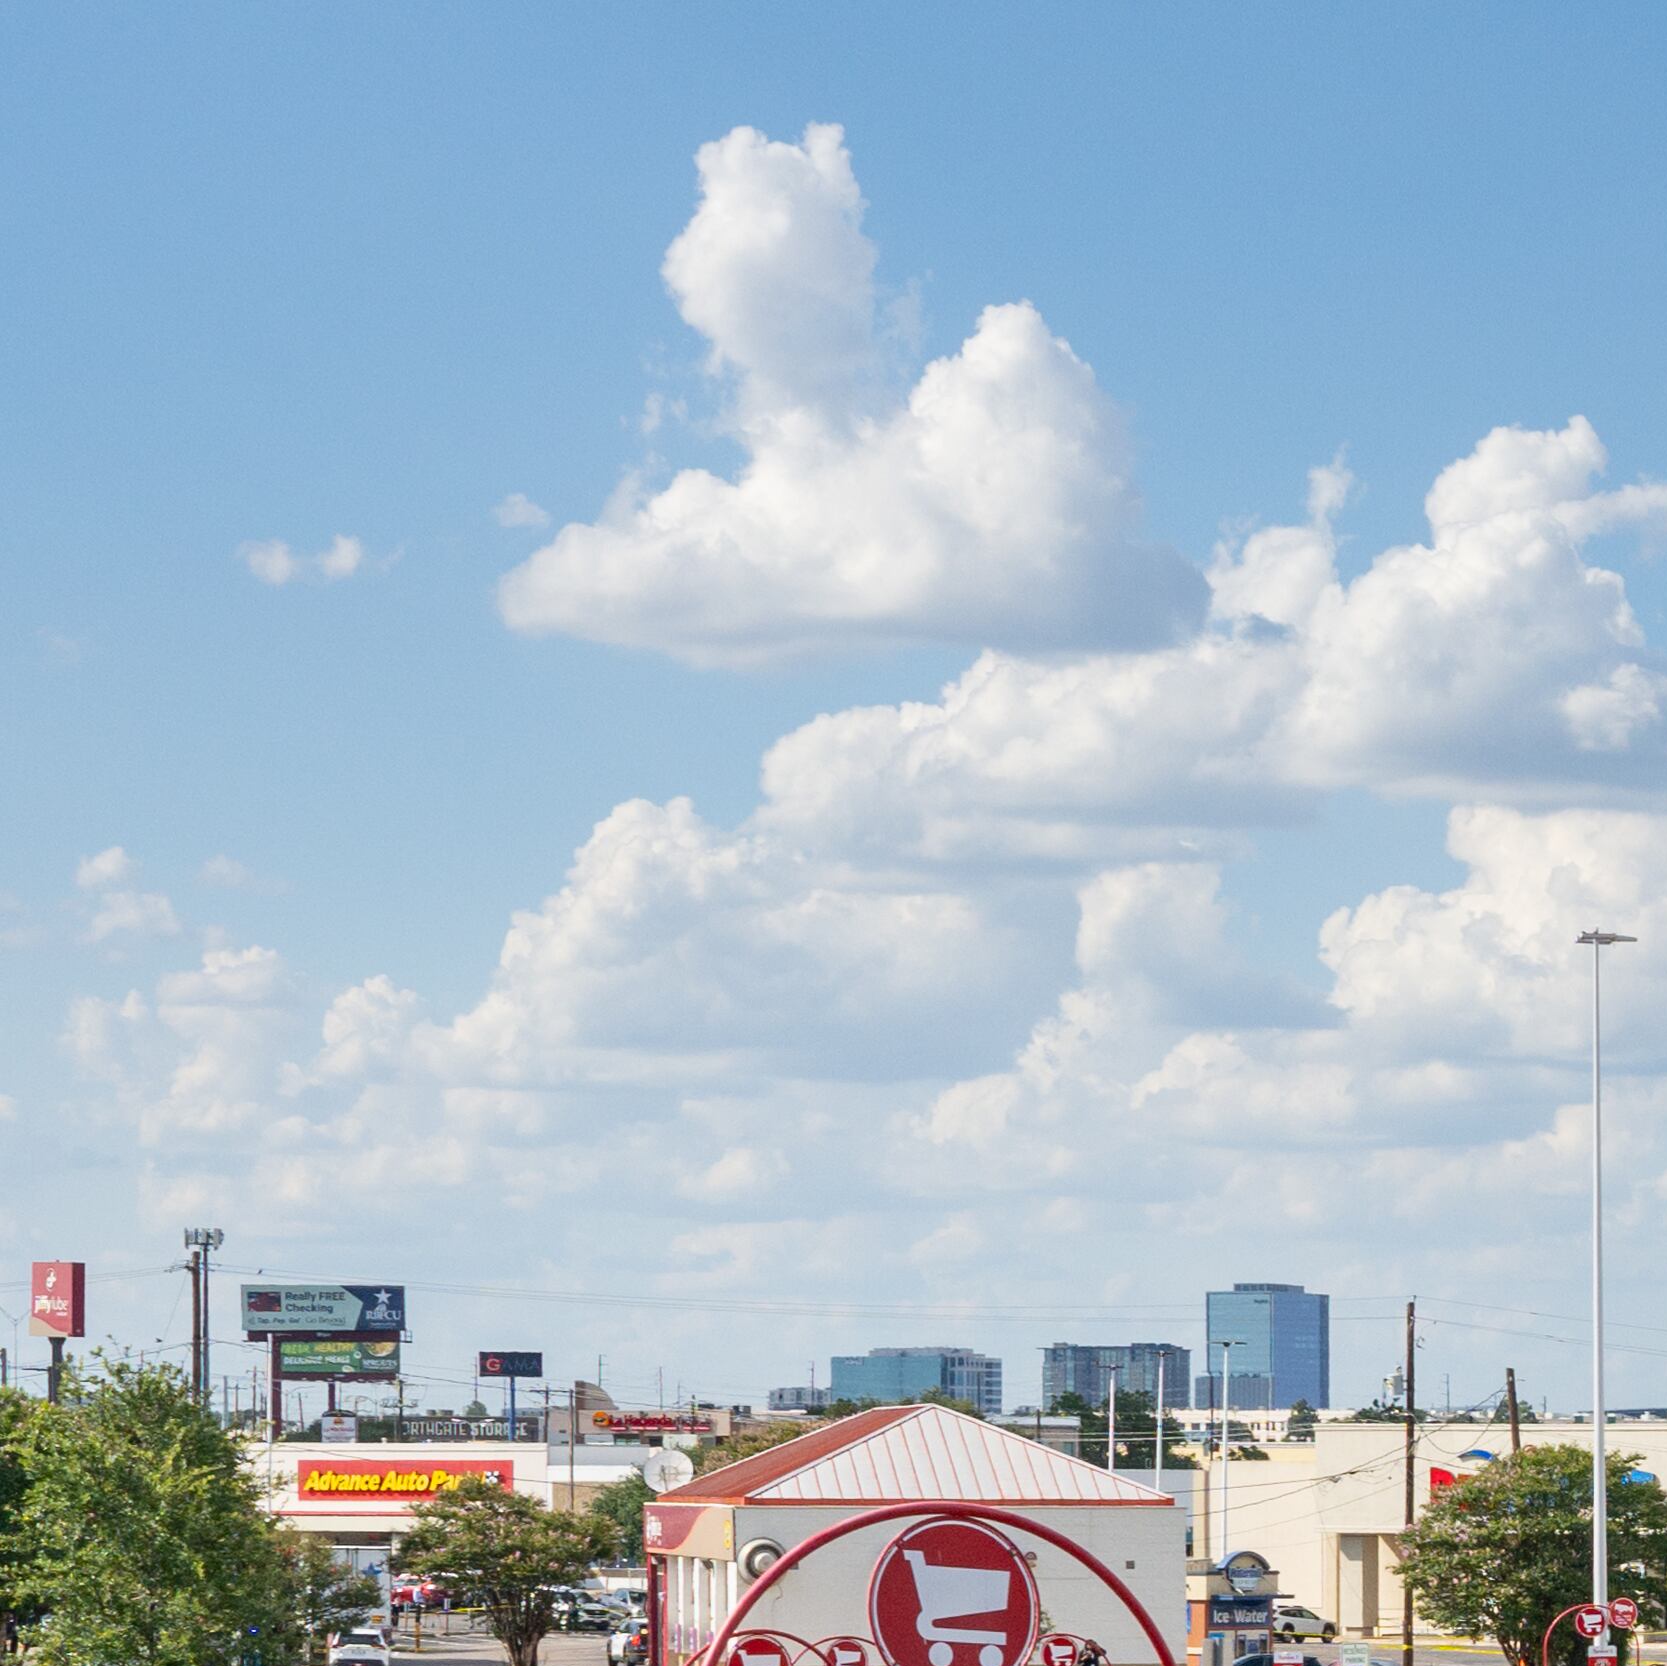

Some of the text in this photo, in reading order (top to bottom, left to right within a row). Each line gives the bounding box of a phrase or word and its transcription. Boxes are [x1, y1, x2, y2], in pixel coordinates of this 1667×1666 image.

[285, 1292, 346, 1301] Really FREE
[285, 1304, 333, 1313] Checking
[402, 1421, 466, 1436] ORTHGATE
[304, 1470, 380, 1491] Advance
[380, 1471, 429, 1491] Auto
[1233, 1609, 1268, 1623] Water
